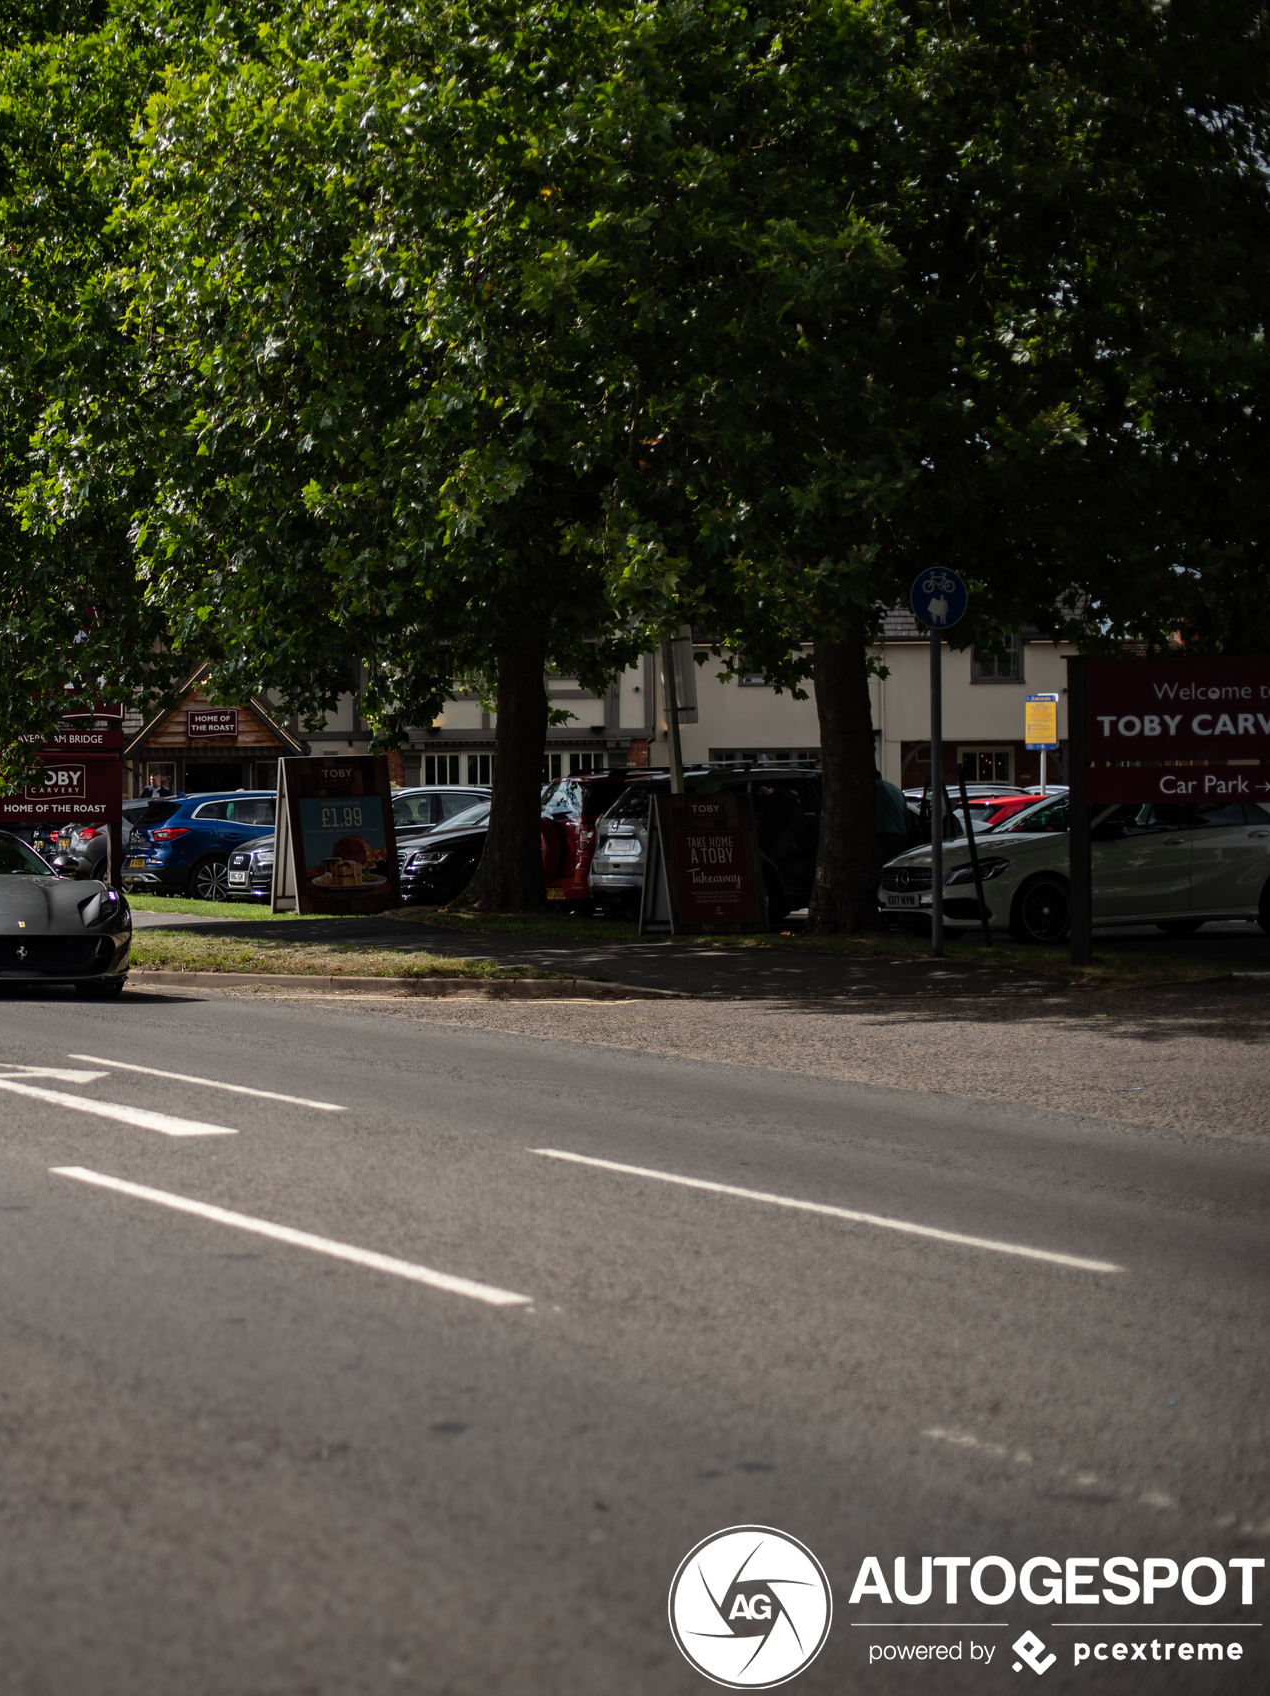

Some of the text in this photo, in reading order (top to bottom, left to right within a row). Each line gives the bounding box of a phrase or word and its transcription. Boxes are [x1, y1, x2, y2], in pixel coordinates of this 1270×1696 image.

[1153, 682, 1270, 701] Welcome t
[1097, 715, 1183, 738] TOBY
[70, 735, 103, 744] BRIDGE
[43, 771, 82, 786] OBY
[322, 768, 353, 779] TOBY
[1159, 776, 1250, 795] Car Park
[4, 804, 106, 812] HOME OF THE ROAST
[690, 804, 720, 813] TOBY
[321, 807, 362, 828] £1.99
[687, 836, 734, 848] TAKE HOME
[690, 848, 733, 864] A TOBY
[686, 868, 744, 890] Takeaway
[901, 896, 915, 906] NYN
